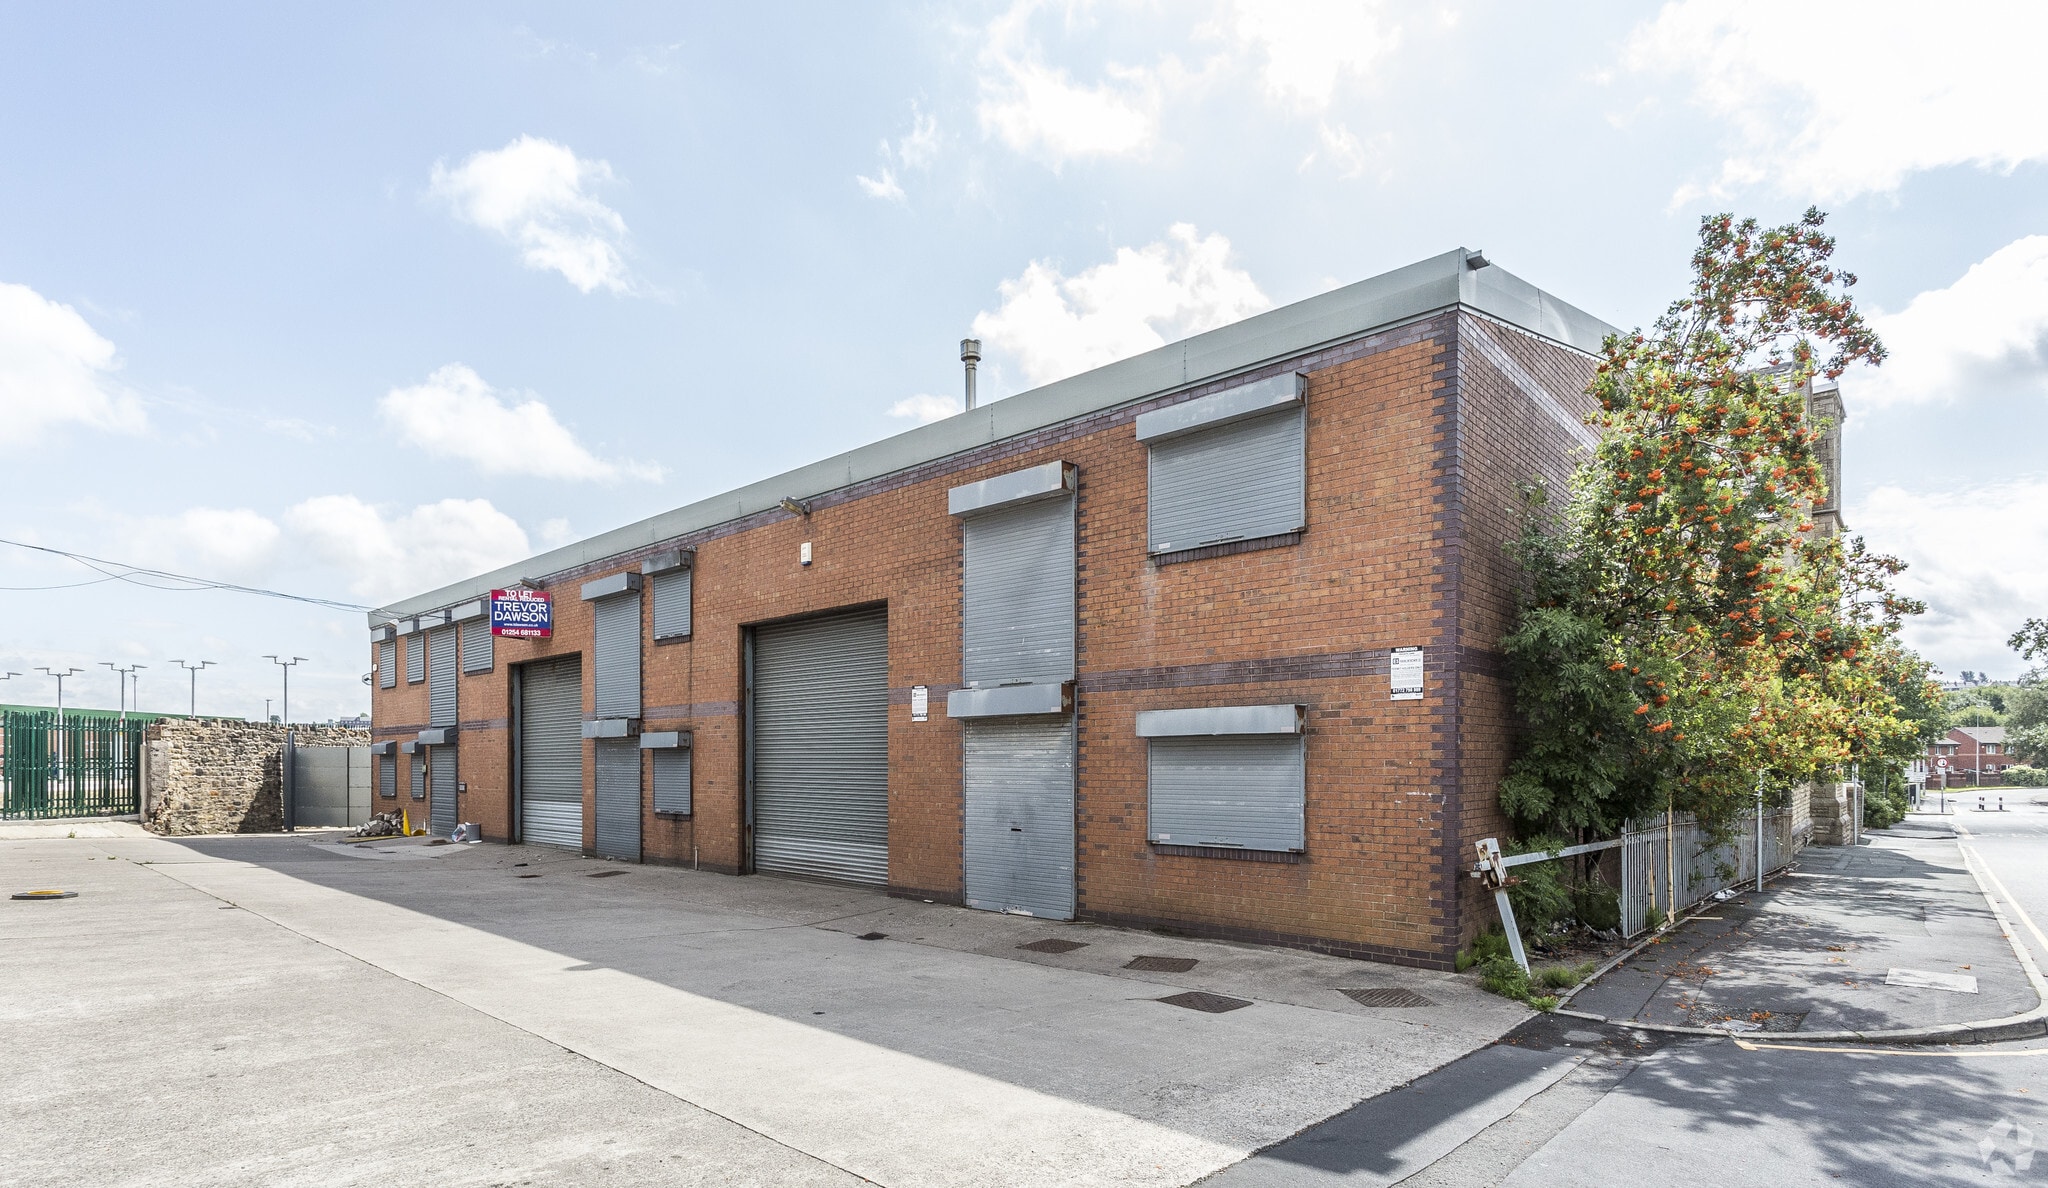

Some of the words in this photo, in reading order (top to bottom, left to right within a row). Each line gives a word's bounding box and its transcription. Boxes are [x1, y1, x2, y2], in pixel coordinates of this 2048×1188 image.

[519, 590, 533, 598] LET
[494, 601, 547, 613] TREVOR
[494, 611, 548, 622] DAWSON
